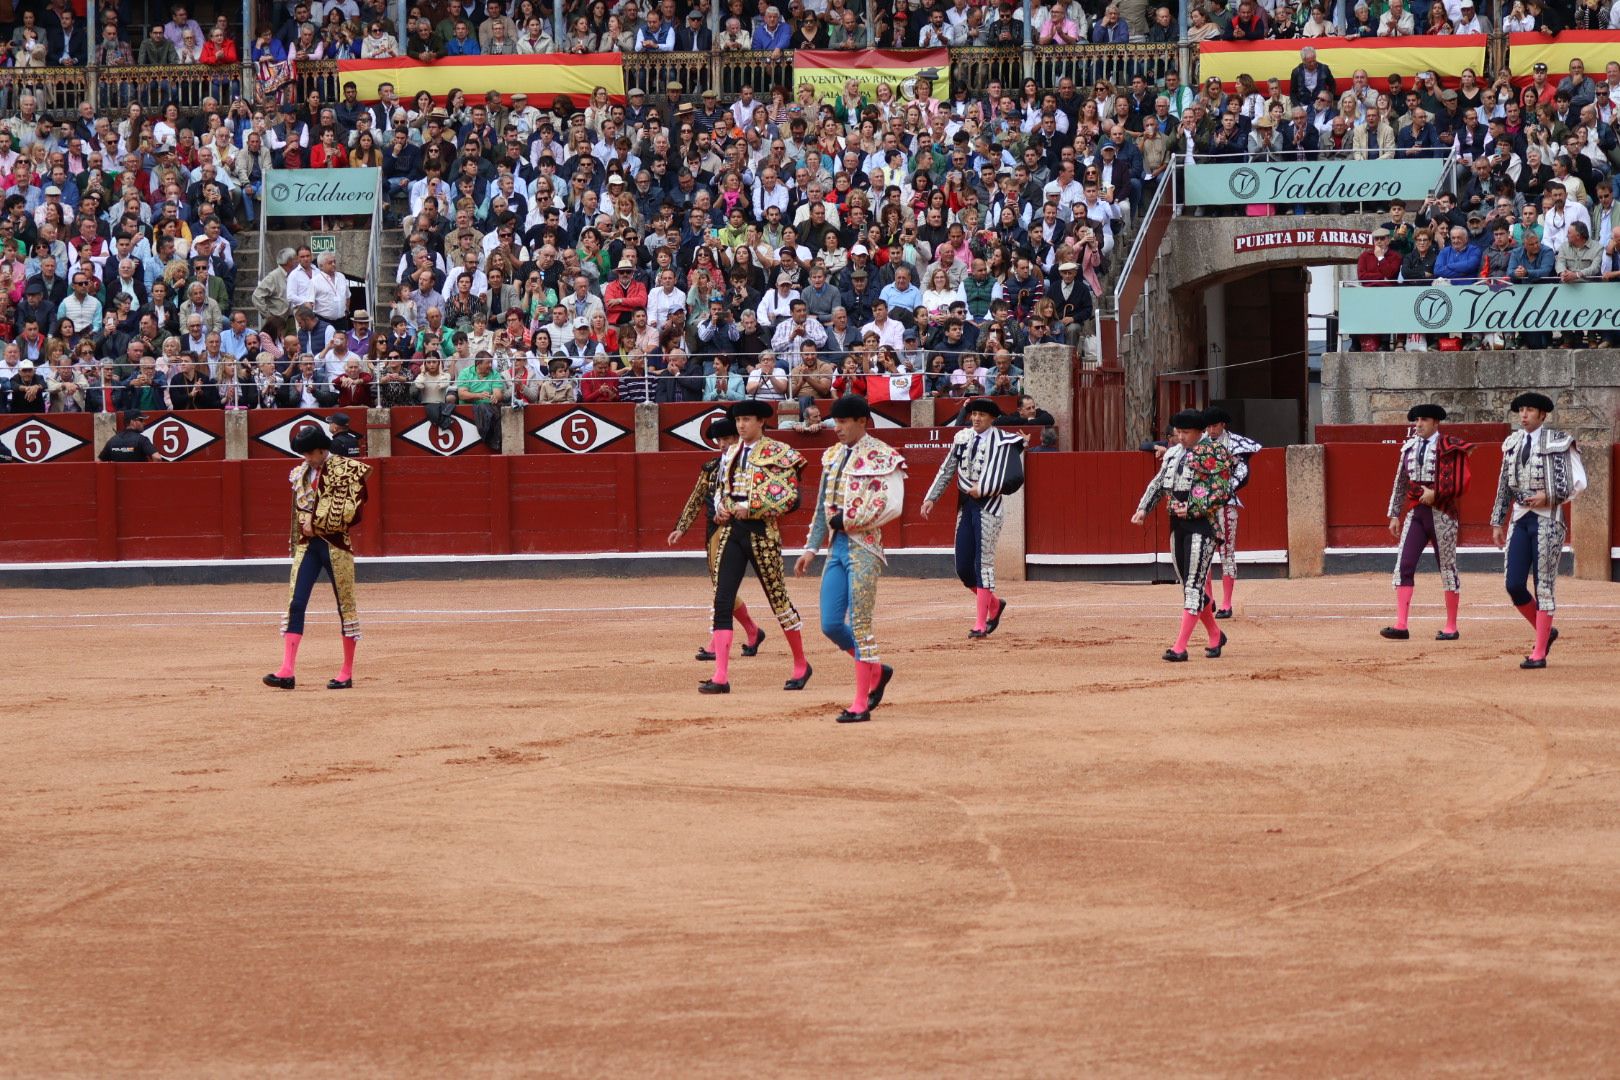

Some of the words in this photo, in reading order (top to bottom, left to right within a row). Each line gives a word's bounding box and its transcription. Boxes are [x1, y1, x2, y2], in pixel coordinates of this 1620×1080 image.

[293, 182, 374, 202] Valduero
[1265, 165, 1401, 199] Valduero
[312, 239, 334, 250] SALIDA
[1236, 232, 1292, 250] PUERTA
[1296, 231, 1315, 243] DE
[163, 426, 179, 453] 5
[437, 427, 455, 450] 5
[571, 418, 589, 445] 5
[929, 429, 939, 441] 11
[25, 430, 42, 457] 5
